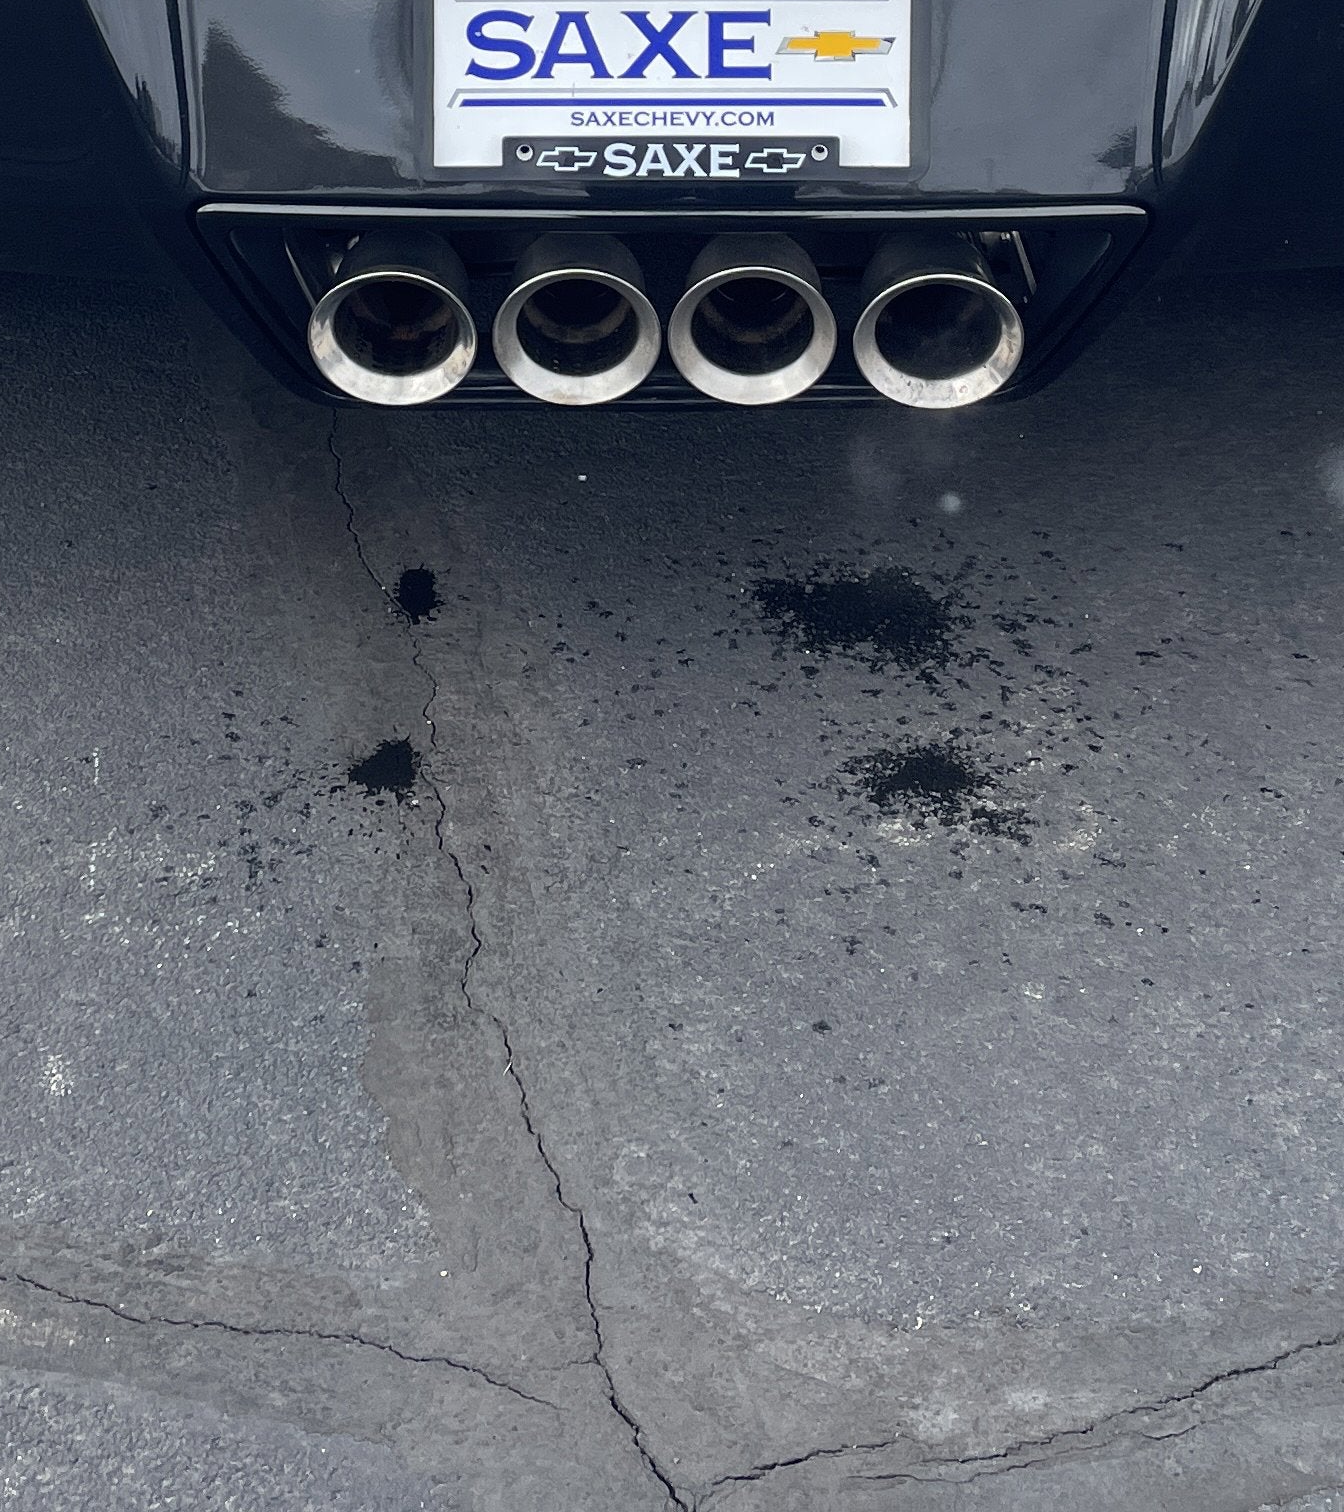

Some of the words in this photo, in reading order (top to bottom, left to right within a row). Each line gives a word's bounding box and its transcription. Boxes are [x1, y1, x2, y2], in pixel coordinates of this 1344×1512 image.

[465, 8, 772, 81] SAXE
[570, 110, 775, 127] SAXECHEVY.COM
[602, 142, 740, 178] SAXE
